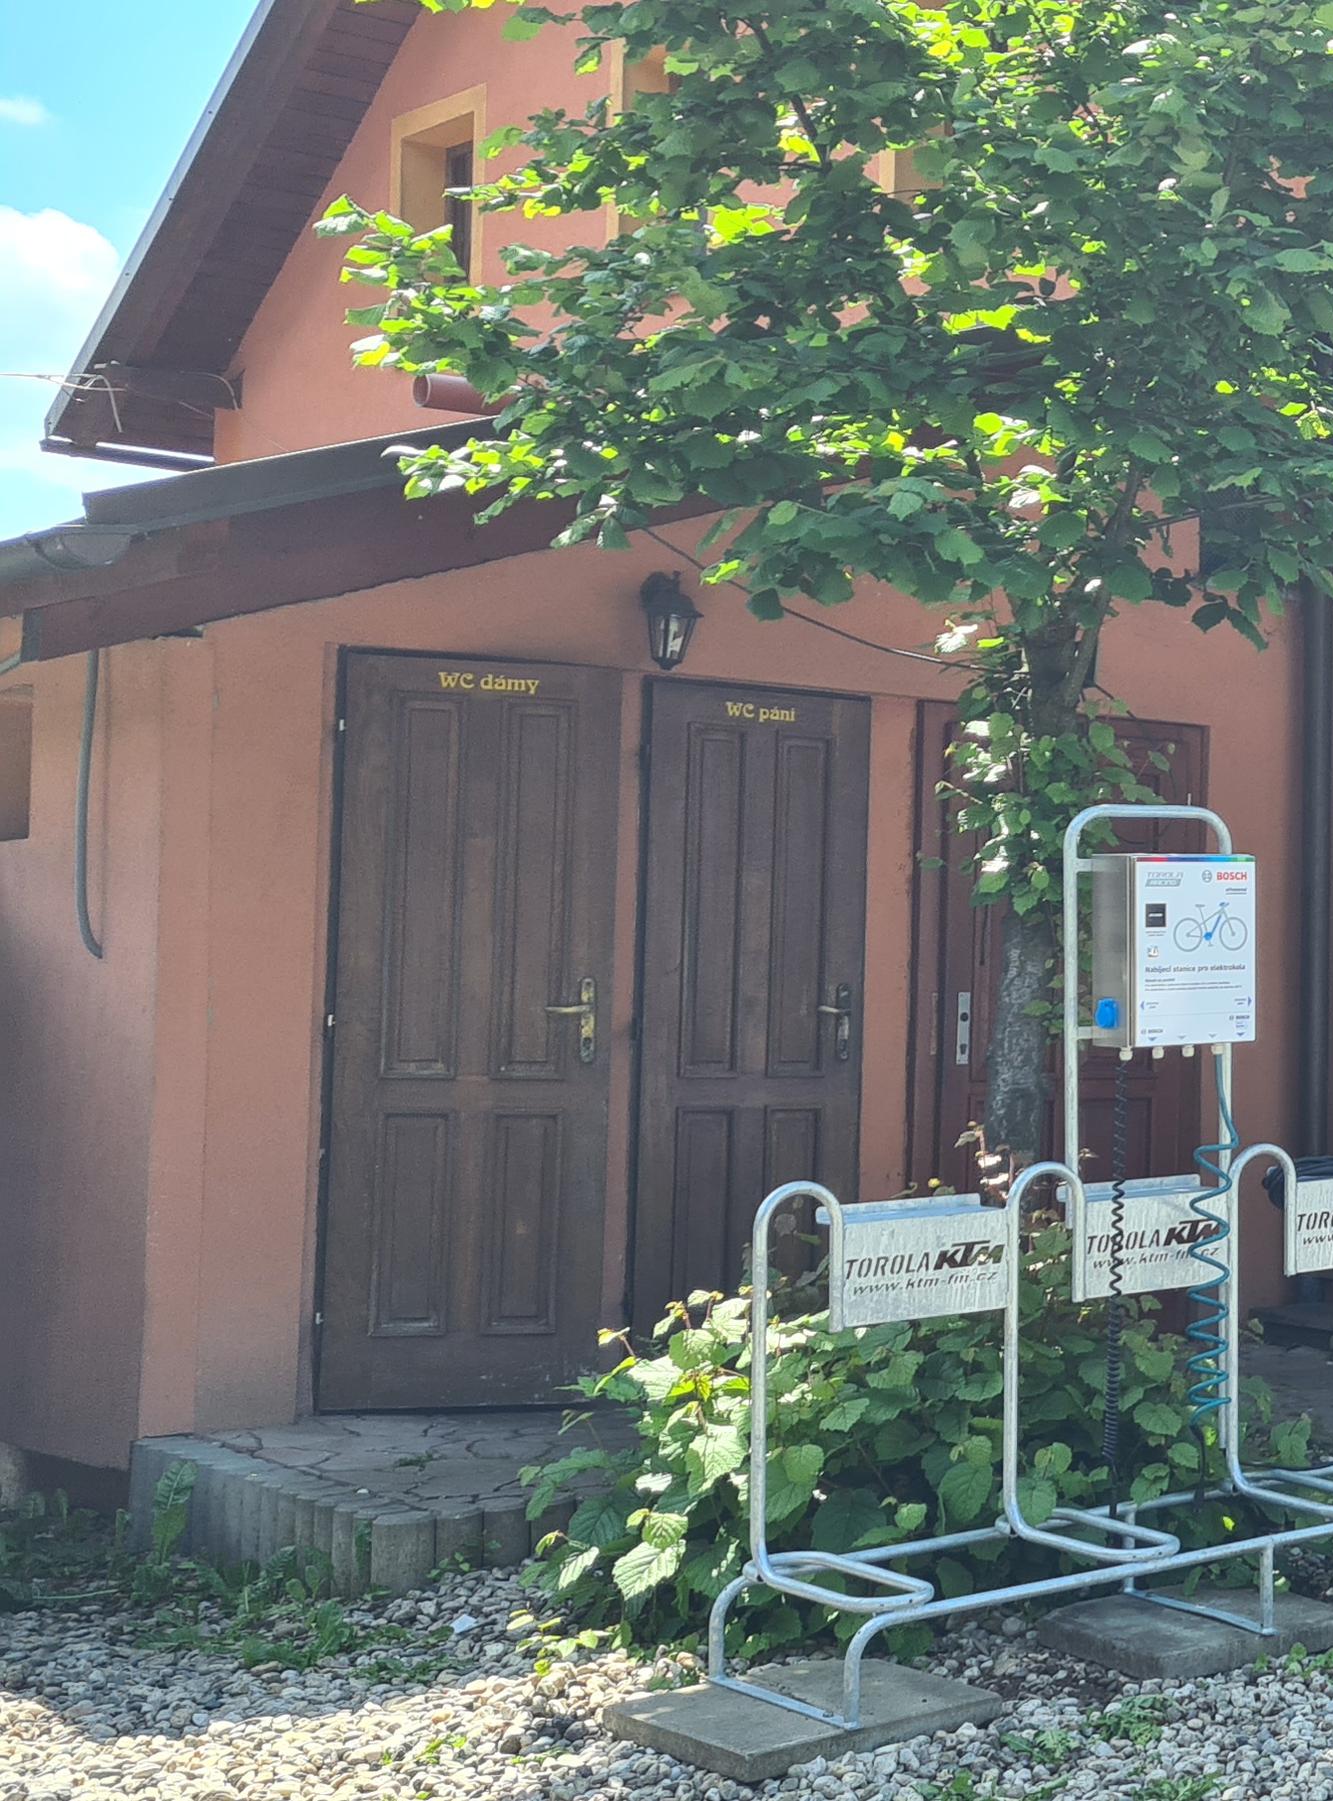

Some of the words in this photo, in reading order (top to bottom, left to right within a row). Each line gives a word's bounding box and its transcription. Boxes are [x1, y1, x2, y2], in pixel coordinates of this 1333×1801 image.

[438, 671, 474, 688] WC
[480, 674, 539, 694] dámy
[726, 701, 754, 717] WC
[1216, 871, 1248, 881] BOSCH
[845, 1251, 930, 1280] TOROLA
[932, 1239, 1006, 1271] KTM
